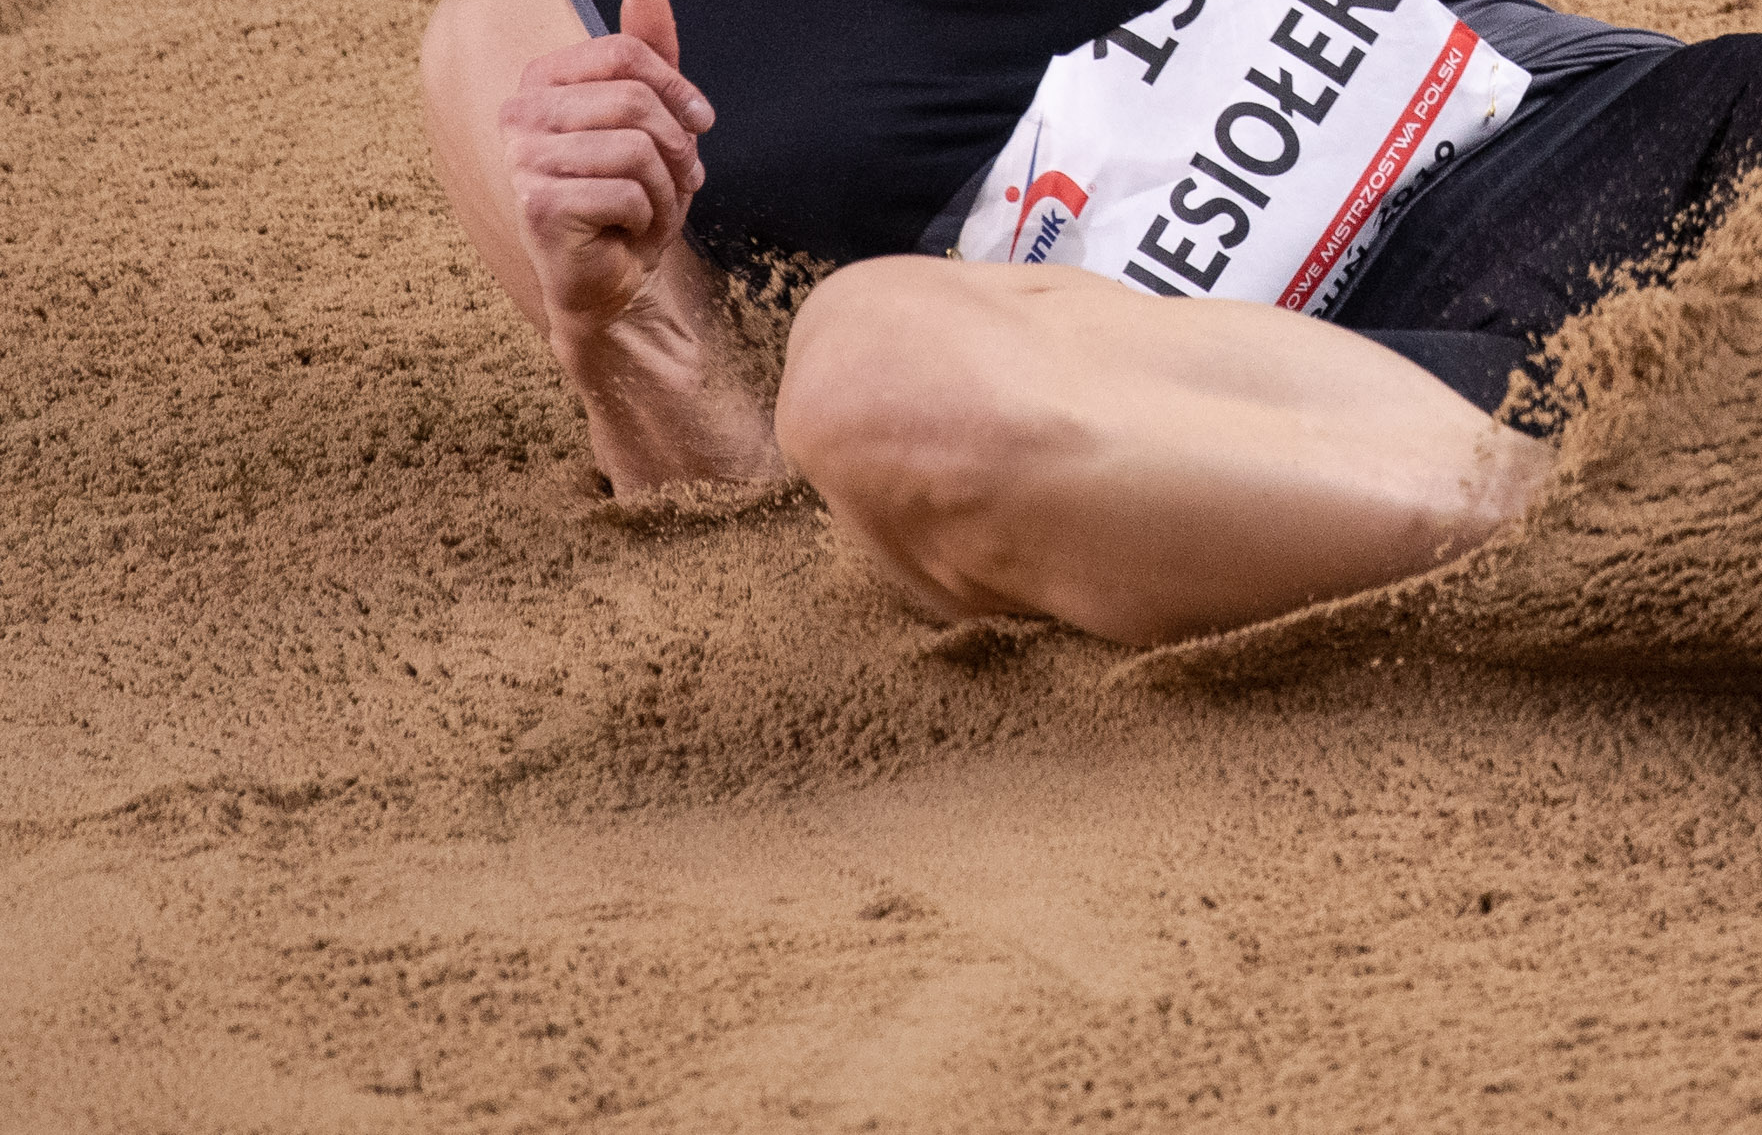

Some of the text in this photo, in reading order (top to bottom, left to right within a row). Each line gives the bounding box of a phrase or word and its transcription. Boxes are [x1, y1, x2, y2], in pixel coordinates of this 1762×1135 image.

[1024, 208, 1067, 264] anik
[1286, 262, 1323, 309] OWE
[1320, 121, 1421, 263] MISTRZOSTWA
[1414, 47, 1464, 119] POLSKI
